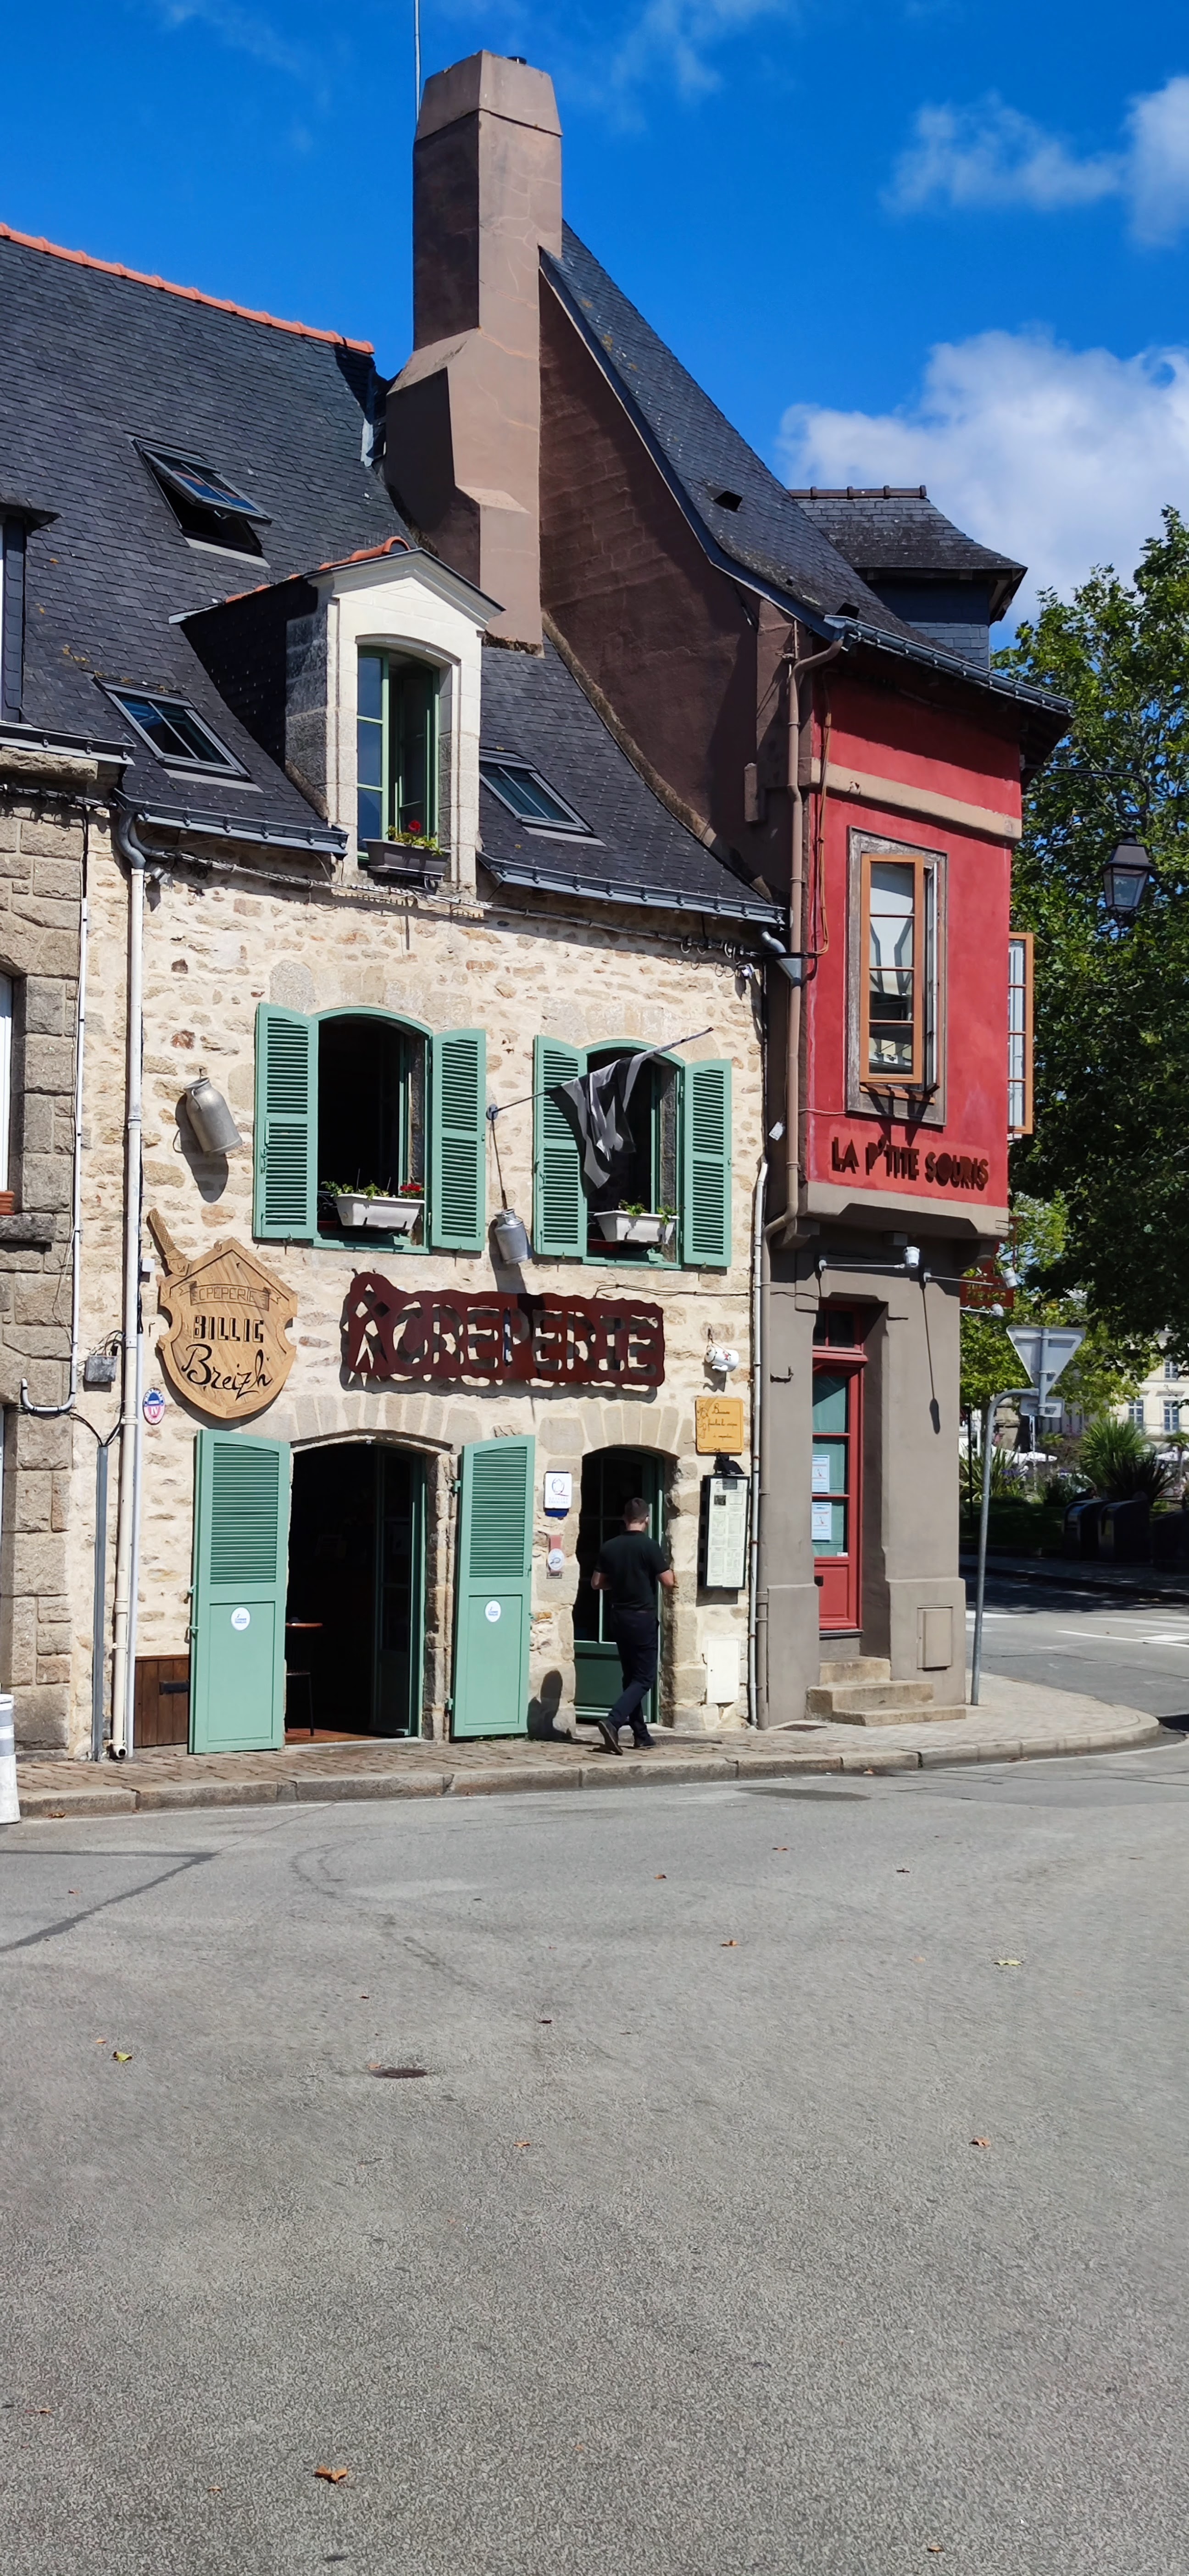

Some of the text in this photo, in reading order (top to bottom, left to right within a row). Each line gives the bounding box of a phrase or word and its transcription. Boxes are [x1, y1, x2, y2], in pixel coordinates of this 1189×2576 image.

[833, 1133, 989, 1188] LA P'TITE SOURIS
[193, 1314, 264, 1344] BILLIG
[181, 1344, 273, 1401] Breizh
